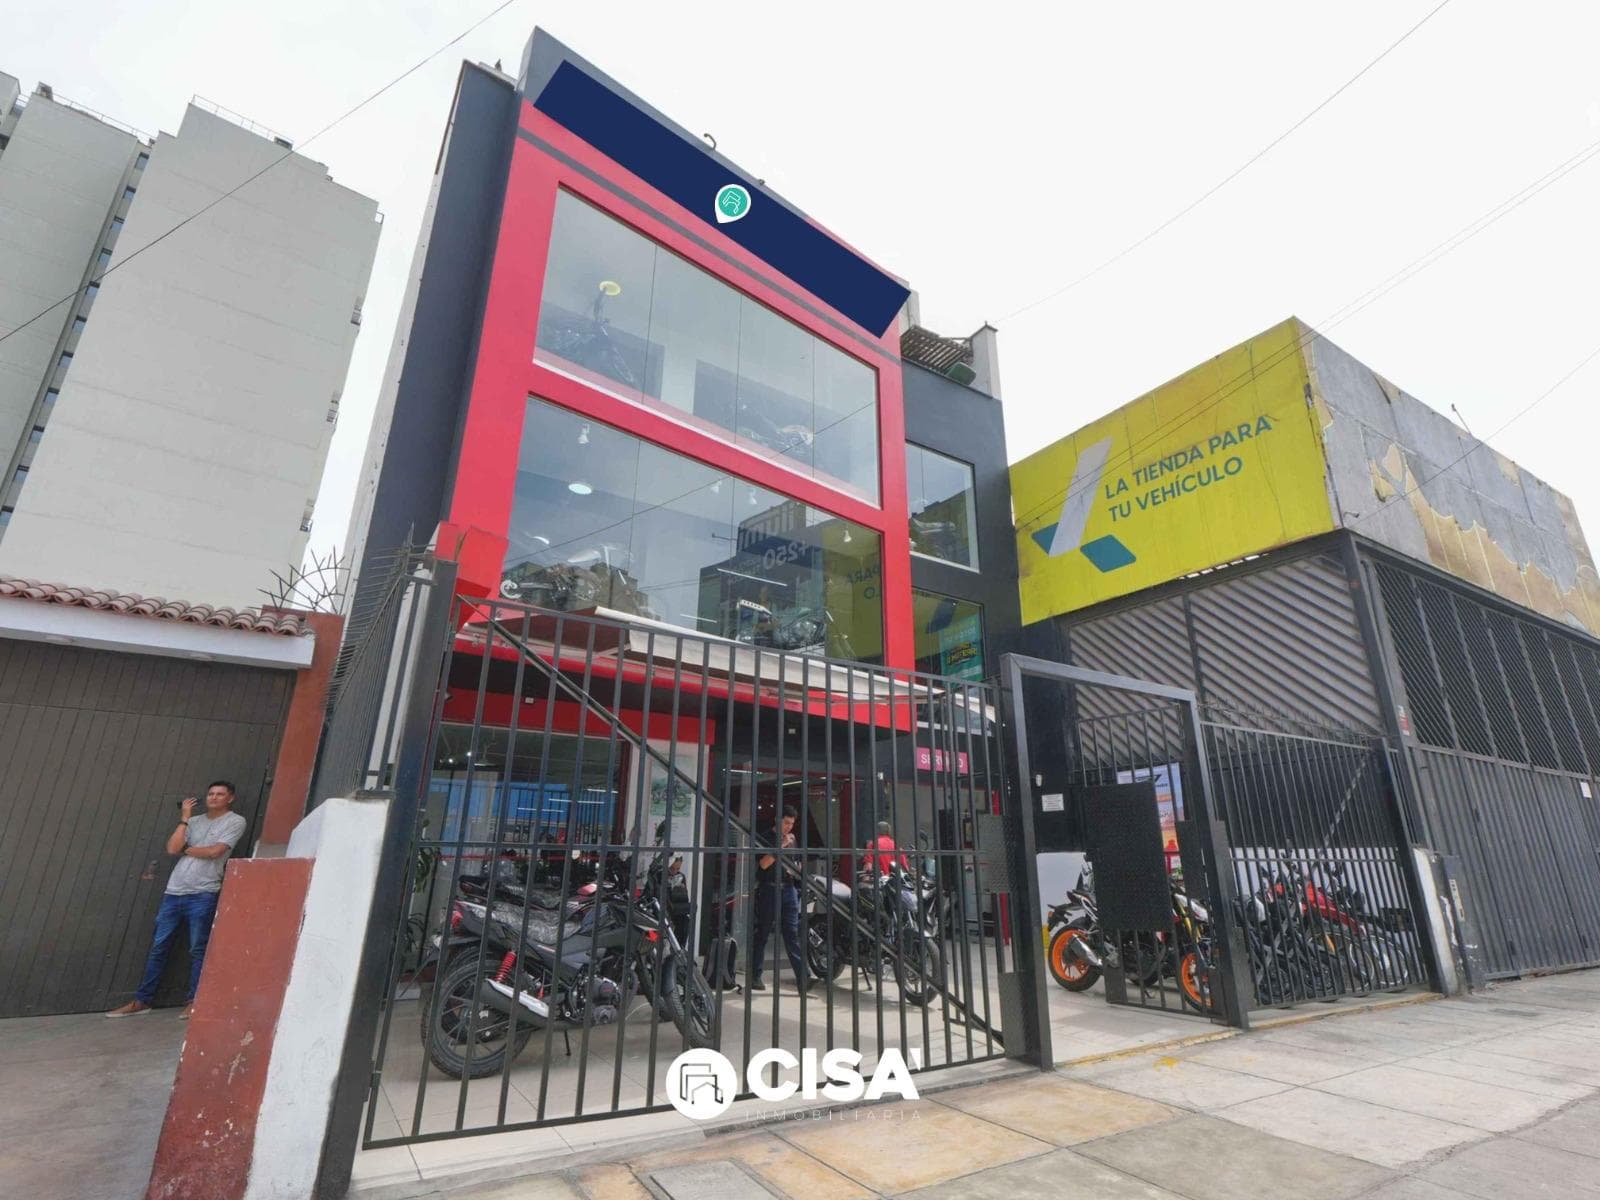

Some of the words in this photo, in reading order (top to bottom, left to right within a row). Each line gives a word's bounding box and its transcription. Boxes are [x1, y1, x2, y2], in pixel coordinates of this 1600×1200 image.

[1105, 477, 1129, 500] LA
[1132, 445, 1204, 487] TIENDA
[1208, 415, 1272, 455] PARA
[1108, 502, 1131, 522] TU
[1135, 456, 1243, 511] VEHÍCULO
